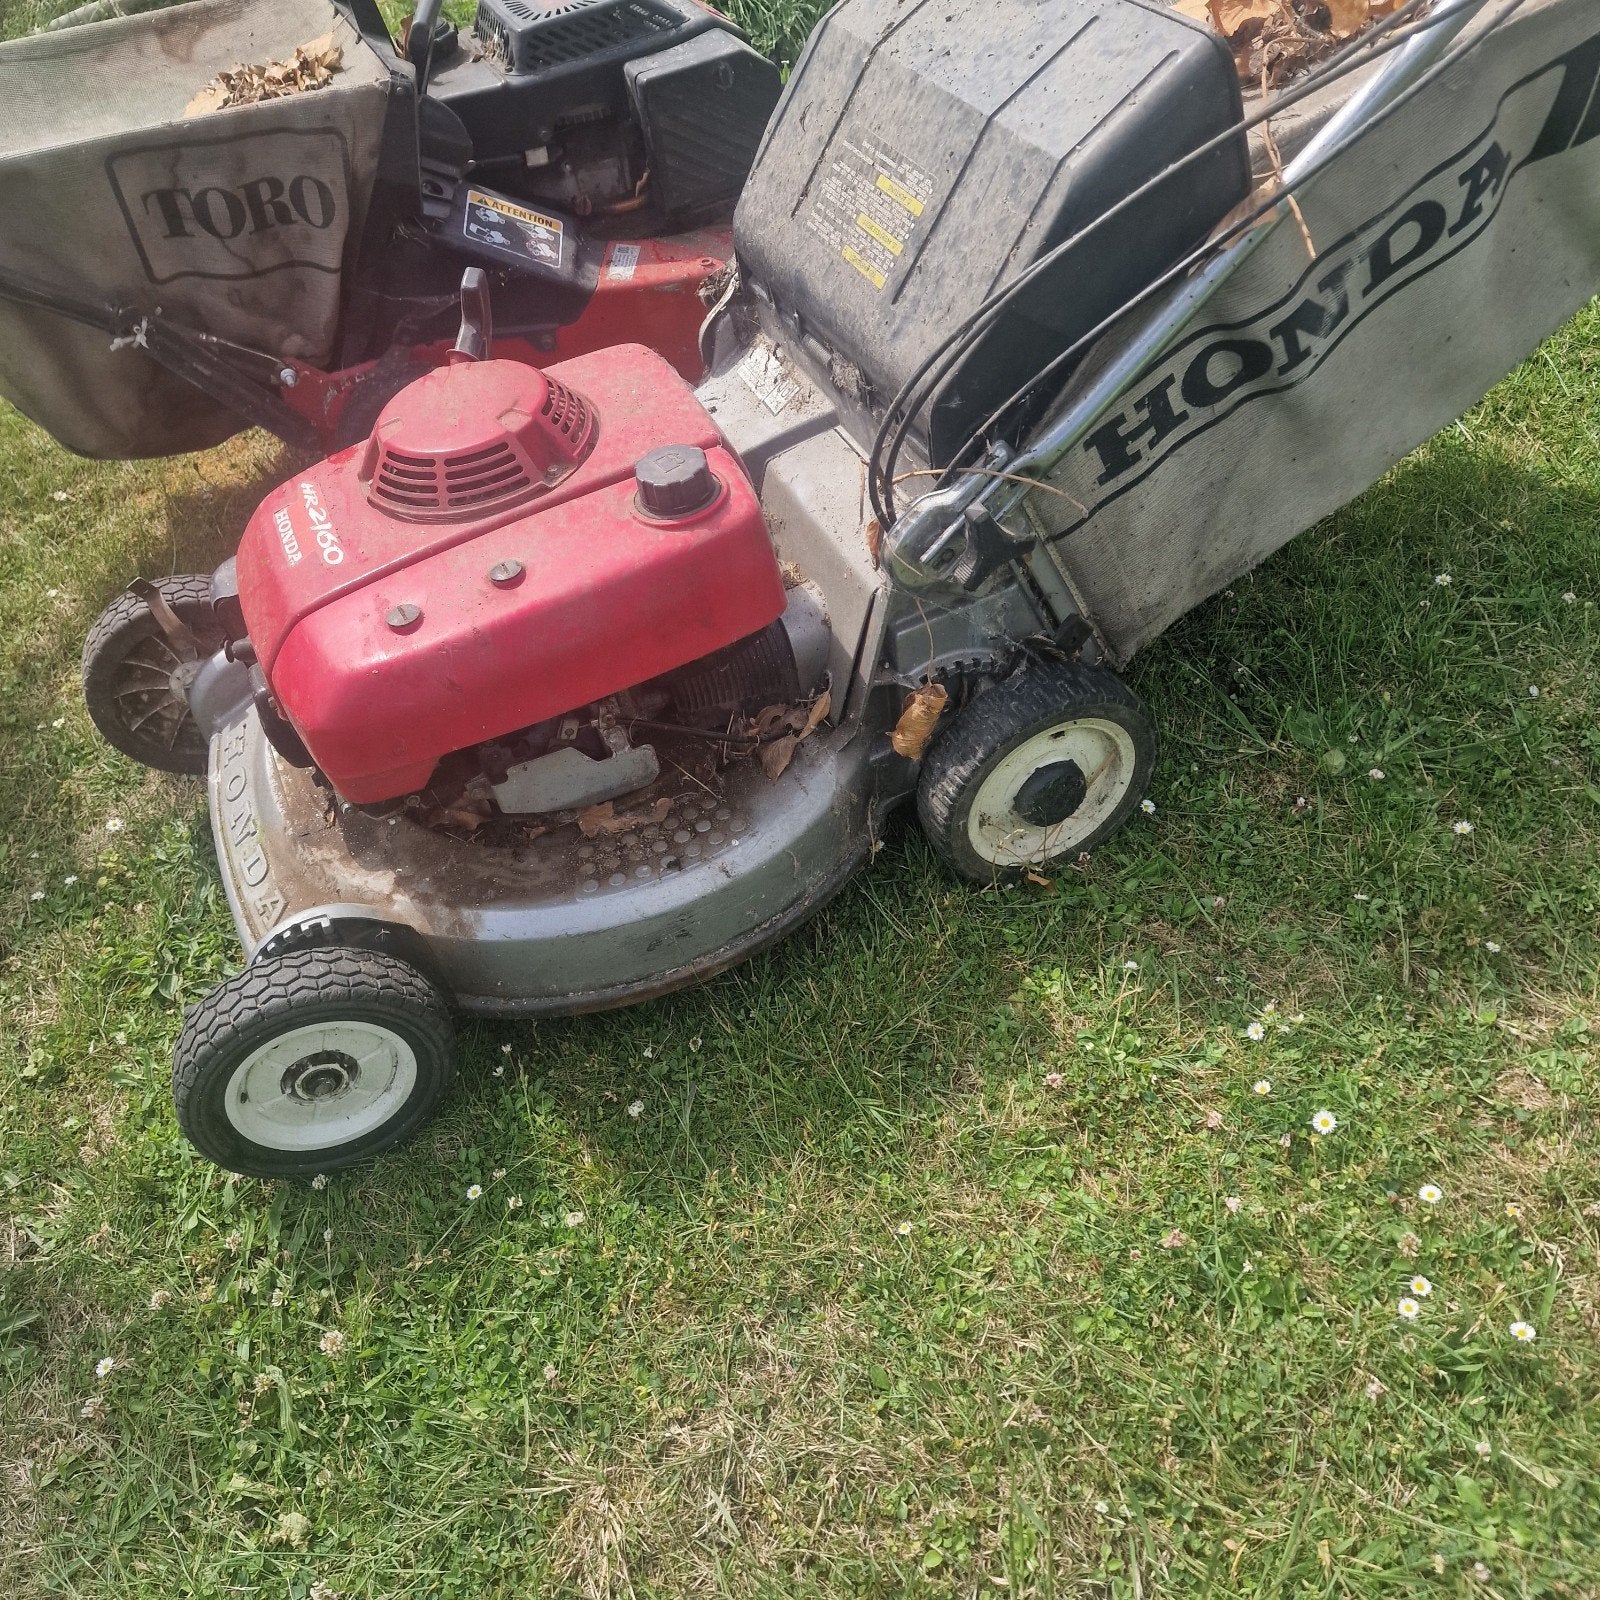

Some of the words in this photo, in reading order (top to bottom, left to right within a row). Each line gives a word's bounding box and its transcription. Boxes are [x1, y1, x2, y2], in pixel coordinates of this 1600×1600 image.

[142, 174, 336, 240] TORO
[490, 199, 553, 229] ATTENTION
[1084, 141, 1510, 487] HONDA
[274, 507, 303, 568] HONDA
[300, 481, 344, 565] HR2160
[224, 723, 288, 930] HONDA
